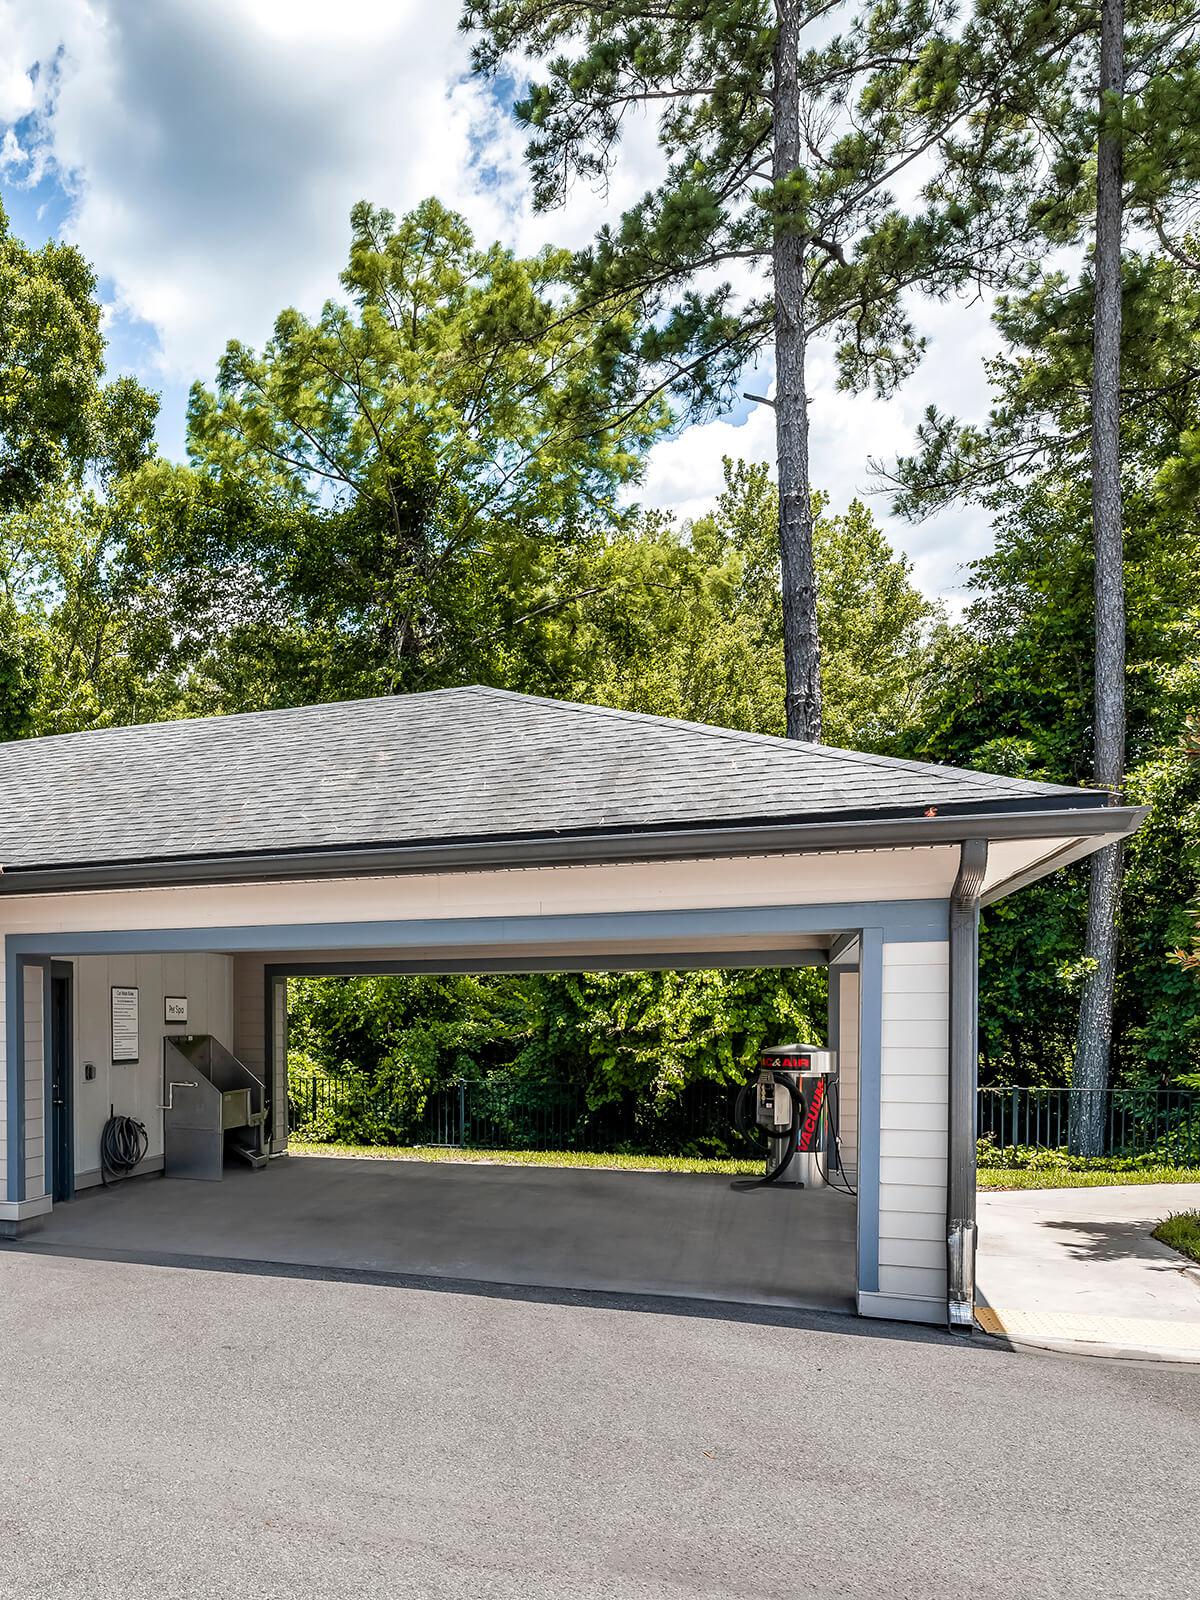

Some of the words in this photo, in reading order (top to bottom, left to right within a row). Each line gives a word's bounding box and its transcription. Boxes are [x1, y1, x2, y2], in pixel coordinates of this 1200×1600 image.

[175, 1004, 185, 1016] Spa
[782, 1057, 810, 1067] AIR
[797, 1080, 825, 1151] VACUUM
